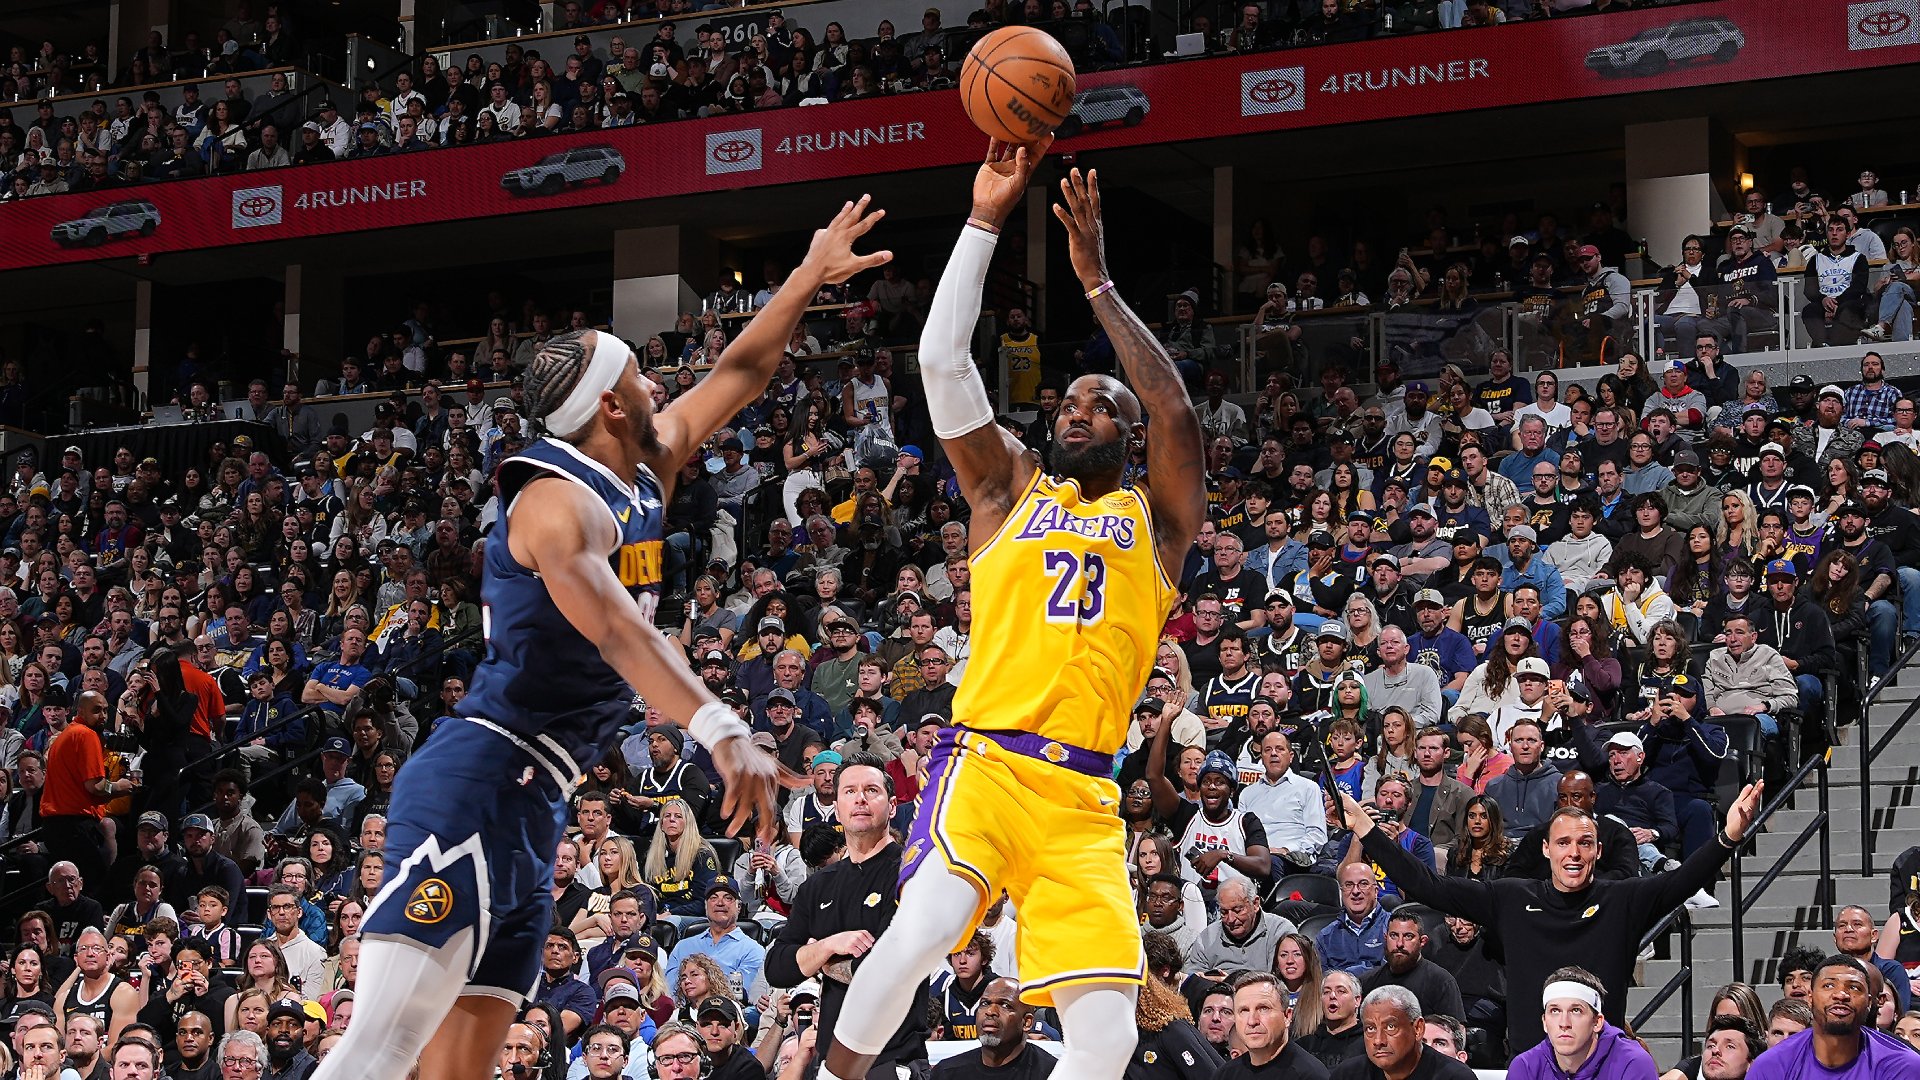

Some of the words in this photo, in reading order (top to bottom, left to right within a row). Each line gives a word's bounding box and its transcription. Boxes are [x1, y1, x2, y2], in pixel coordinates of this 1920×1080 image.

[720, 22, 759, 44] 260
[1319, 58, 1490, 94] 4RUNNER
[775, 121, 926, 156] 4RUNNER
[294, 178, 427, 209] 4RUNNER
[1012, 357, 1030, 371] 23
[1481, 388, 1512, 399] DENVER
[1487, 400, 1502, 414] 15
[1014, 497, 1135, 549] LAKERS
[1221, 513, 1243, 528] NVER
[1786, 543, 1815, 555] LAKERS
[1043, 549, 1106, 626] 23
[1467, 622, 1503, 640] LAKERS
[1286, 653, 1299, 670] 15
[1208, 704, 1249, 718] DENVER
[1194, 832, 1229, 852] USA
[60, 921, 79, 938] 27
[953, 1024, 977, 1040] DENV
